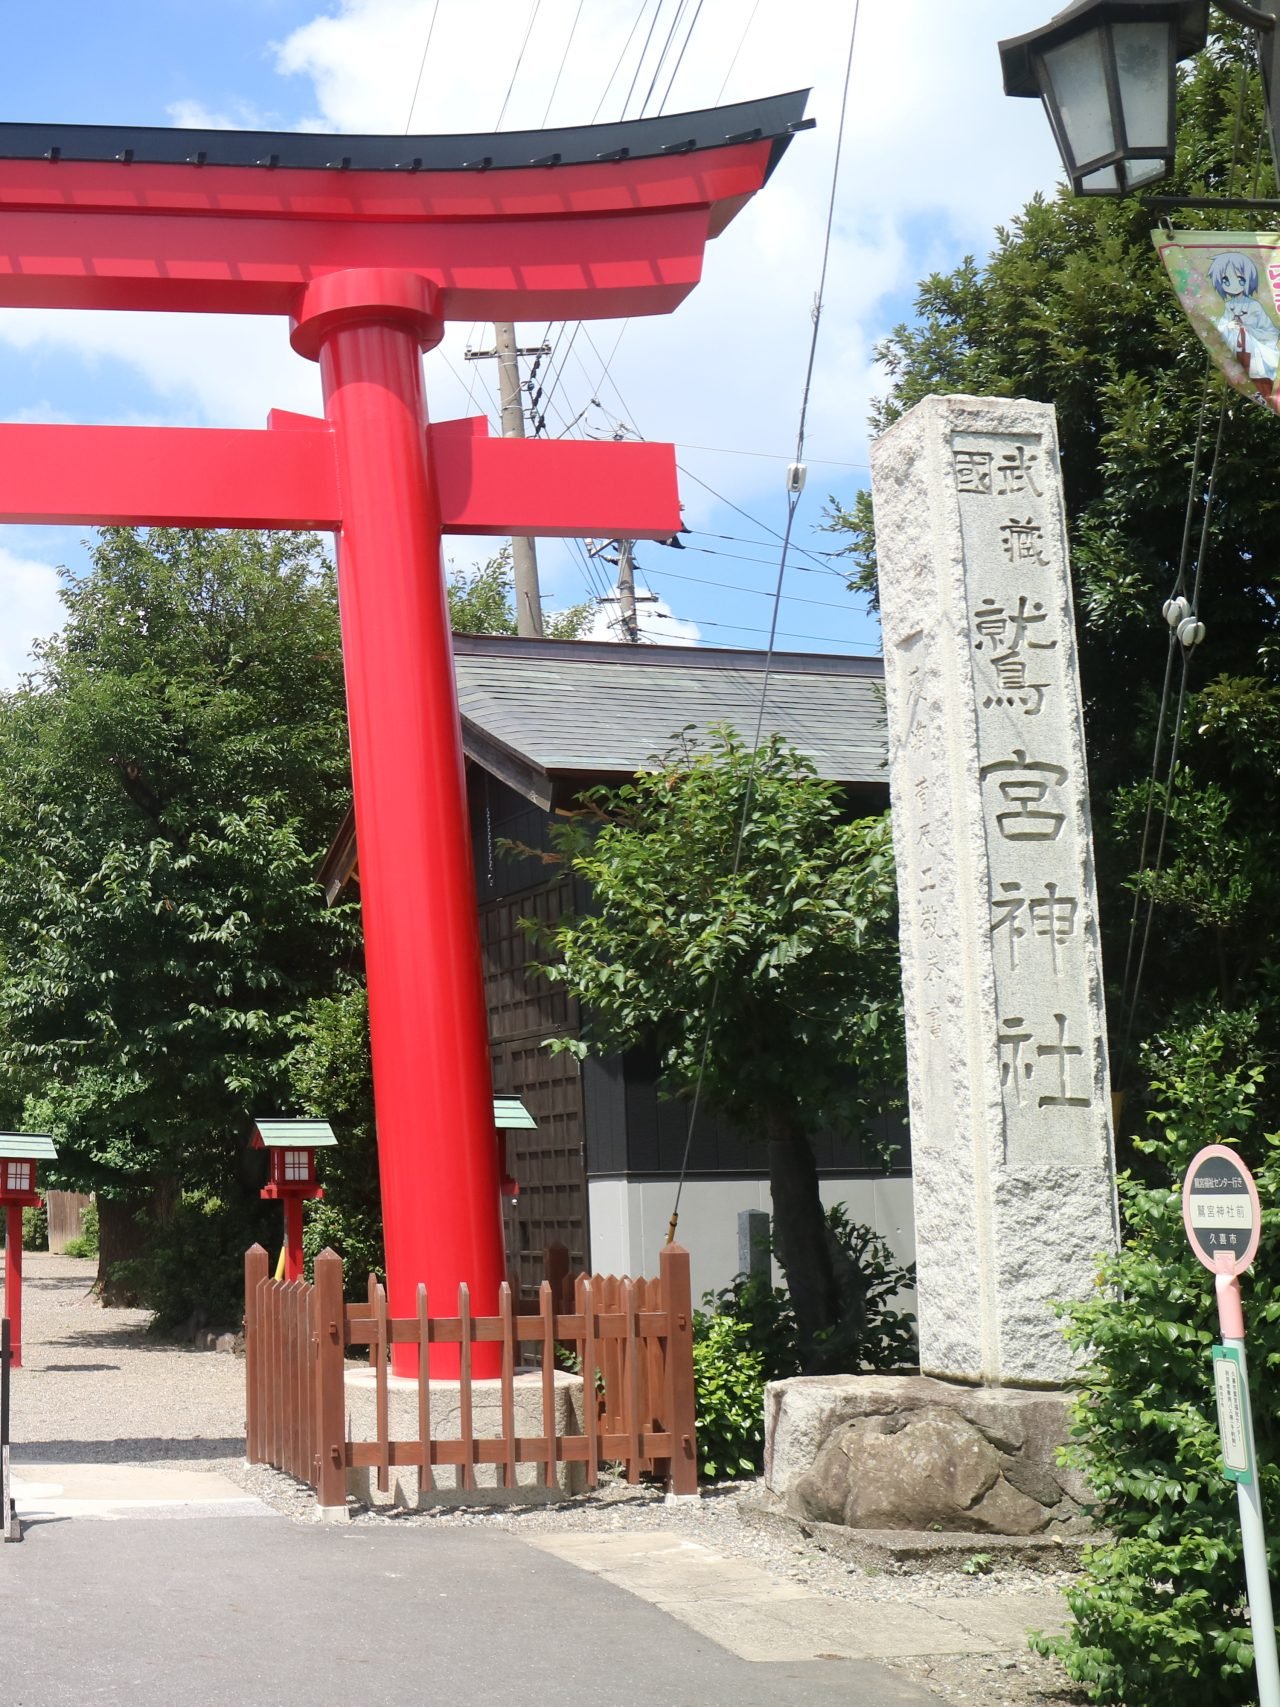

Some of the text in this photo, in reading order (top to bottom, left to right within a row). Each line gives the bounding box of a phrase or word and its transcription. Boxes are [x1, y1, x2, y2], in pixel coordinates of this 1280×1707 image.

[1197, 1204, 1245, 1219] 鷲宮神社前
[1209, 1233, 1237, 1246] 久喜市
